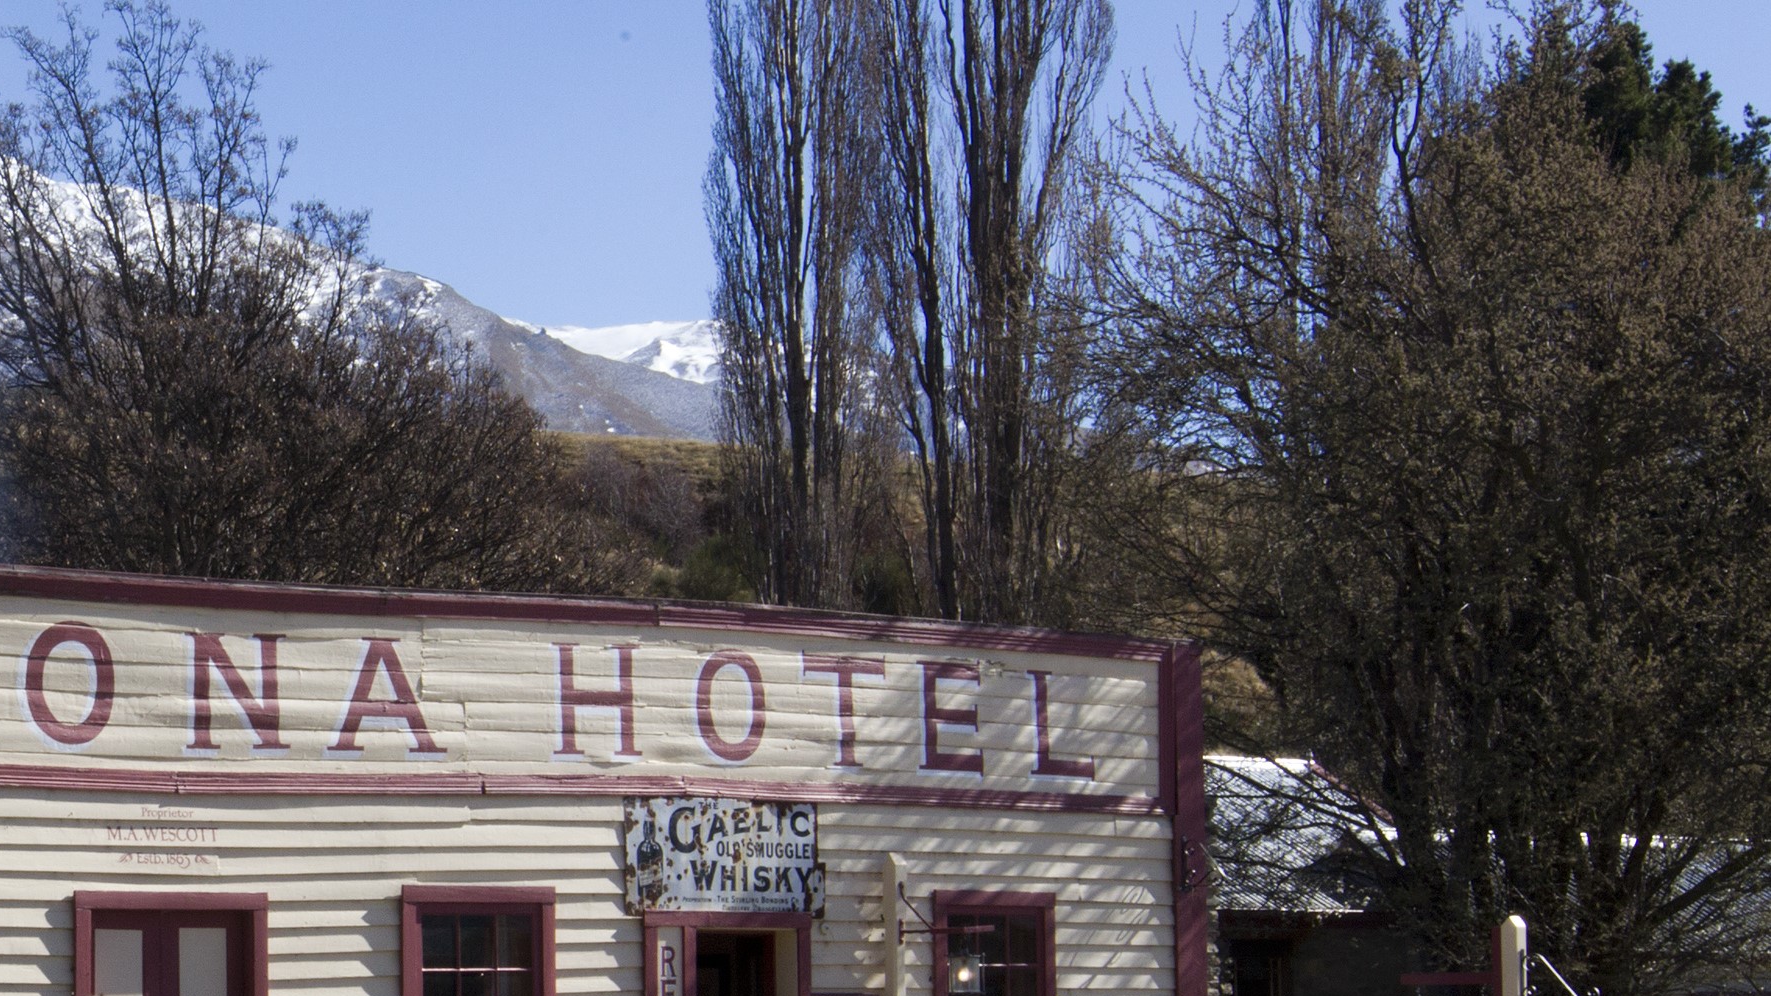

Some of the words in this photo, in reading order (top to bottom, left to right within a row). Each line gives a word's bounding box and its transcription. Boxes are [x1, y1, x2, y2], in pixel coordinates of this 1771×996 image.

[550, 642, 1095, 783] HOTEL
[141, 807, 194, 819] Proprietor
[668, 806, 811, 854] GAELIC
